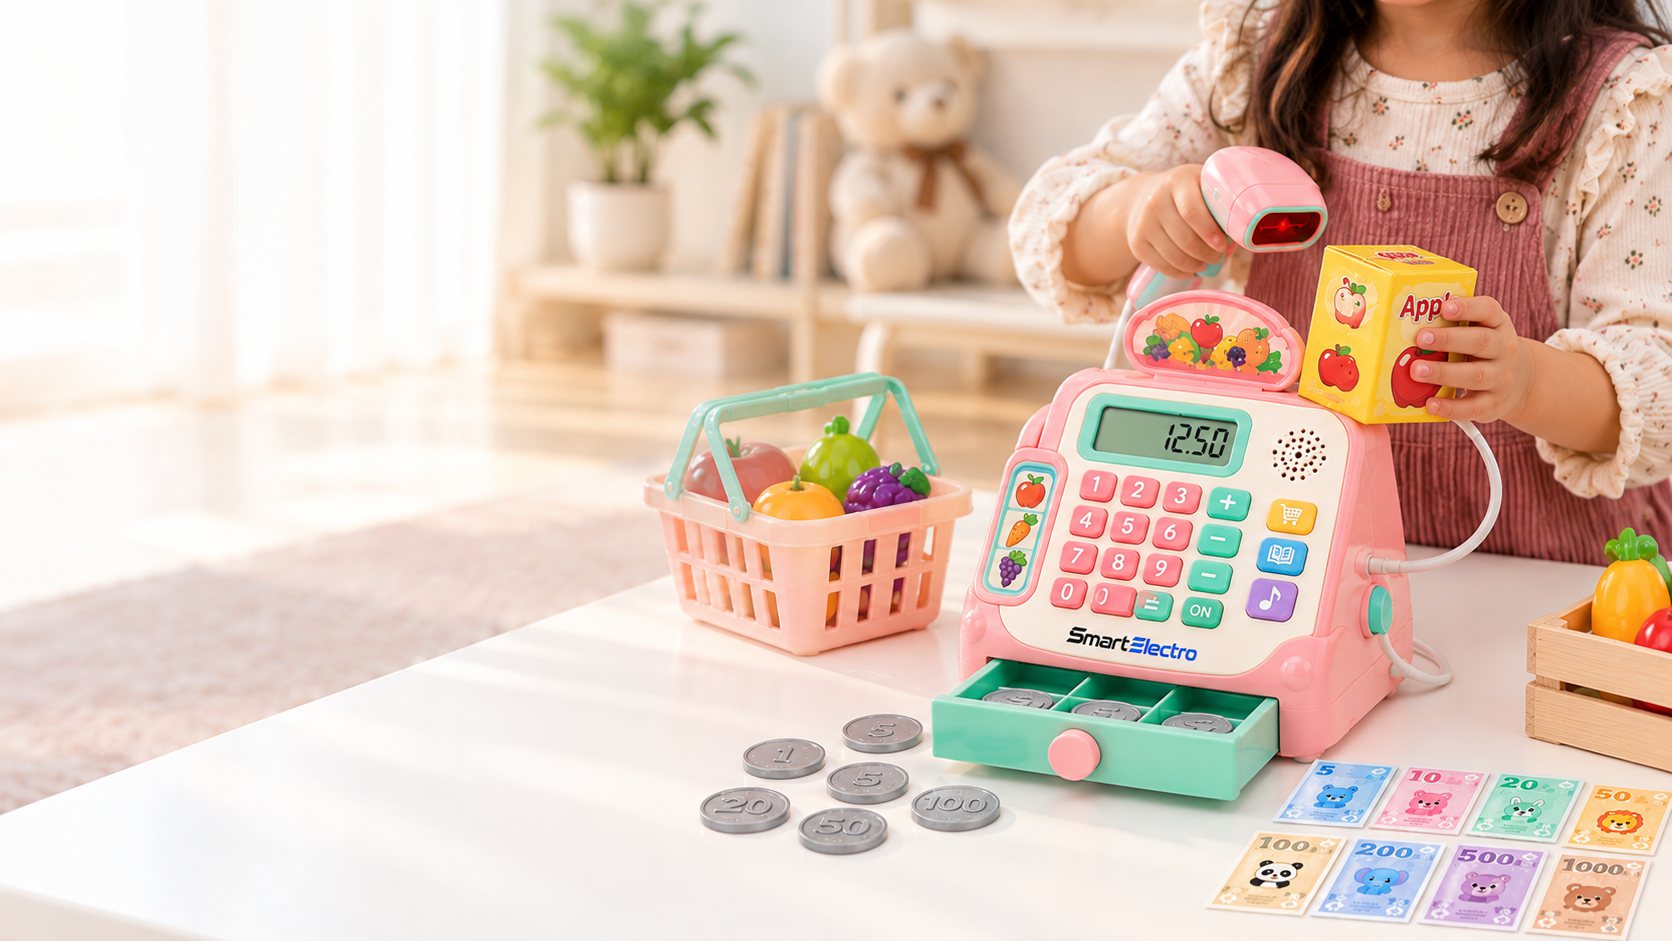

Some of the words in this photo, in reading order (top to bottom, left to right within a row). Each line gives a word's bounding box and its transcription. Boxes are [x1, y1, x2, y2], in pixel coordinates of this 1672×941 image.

[1164, 423, 1229, 458] 12.50
[1093, 476, 1101, 493] 1
[1131, 481, 1145, 498] 2
[1174, 487, 1188, 504] 3
[1079, 511, 1092, 528] 4
[1121, 517, 1135, 534] 5
[1163, 523, 1177, 541] 6
[1071, 547, 1084, 564] 7
[1111, 553, 1126, 571] 8
[1155, 559, 1168, 577] 9
[1060, 582, 1074, 600] 0
[1189, 604, 1212, 618] ON
[1066, 626, 1198, 662] SmartElectro
[868, 722, 896, 738] 5
[773, 747, 795, 764] 1
[853, 769, 883, 787] 5
[1315, 765, 1336, 776] 5
[1408, 770, 1441, 783] 10
[1500, 776, 1539, 791] 20
[1594, 788, 1631, 802] 50
[713, 796, 773, 815] 20
[923, 795, 988, 813] 100
[815, 816, 871, 836] 50
[1258, 836, 1310, 852] 100
[1355, 842, 1414, 859] 200
[1457, 848, 1515, 866] 500
[1561, 858, 1625, 876] 1000
